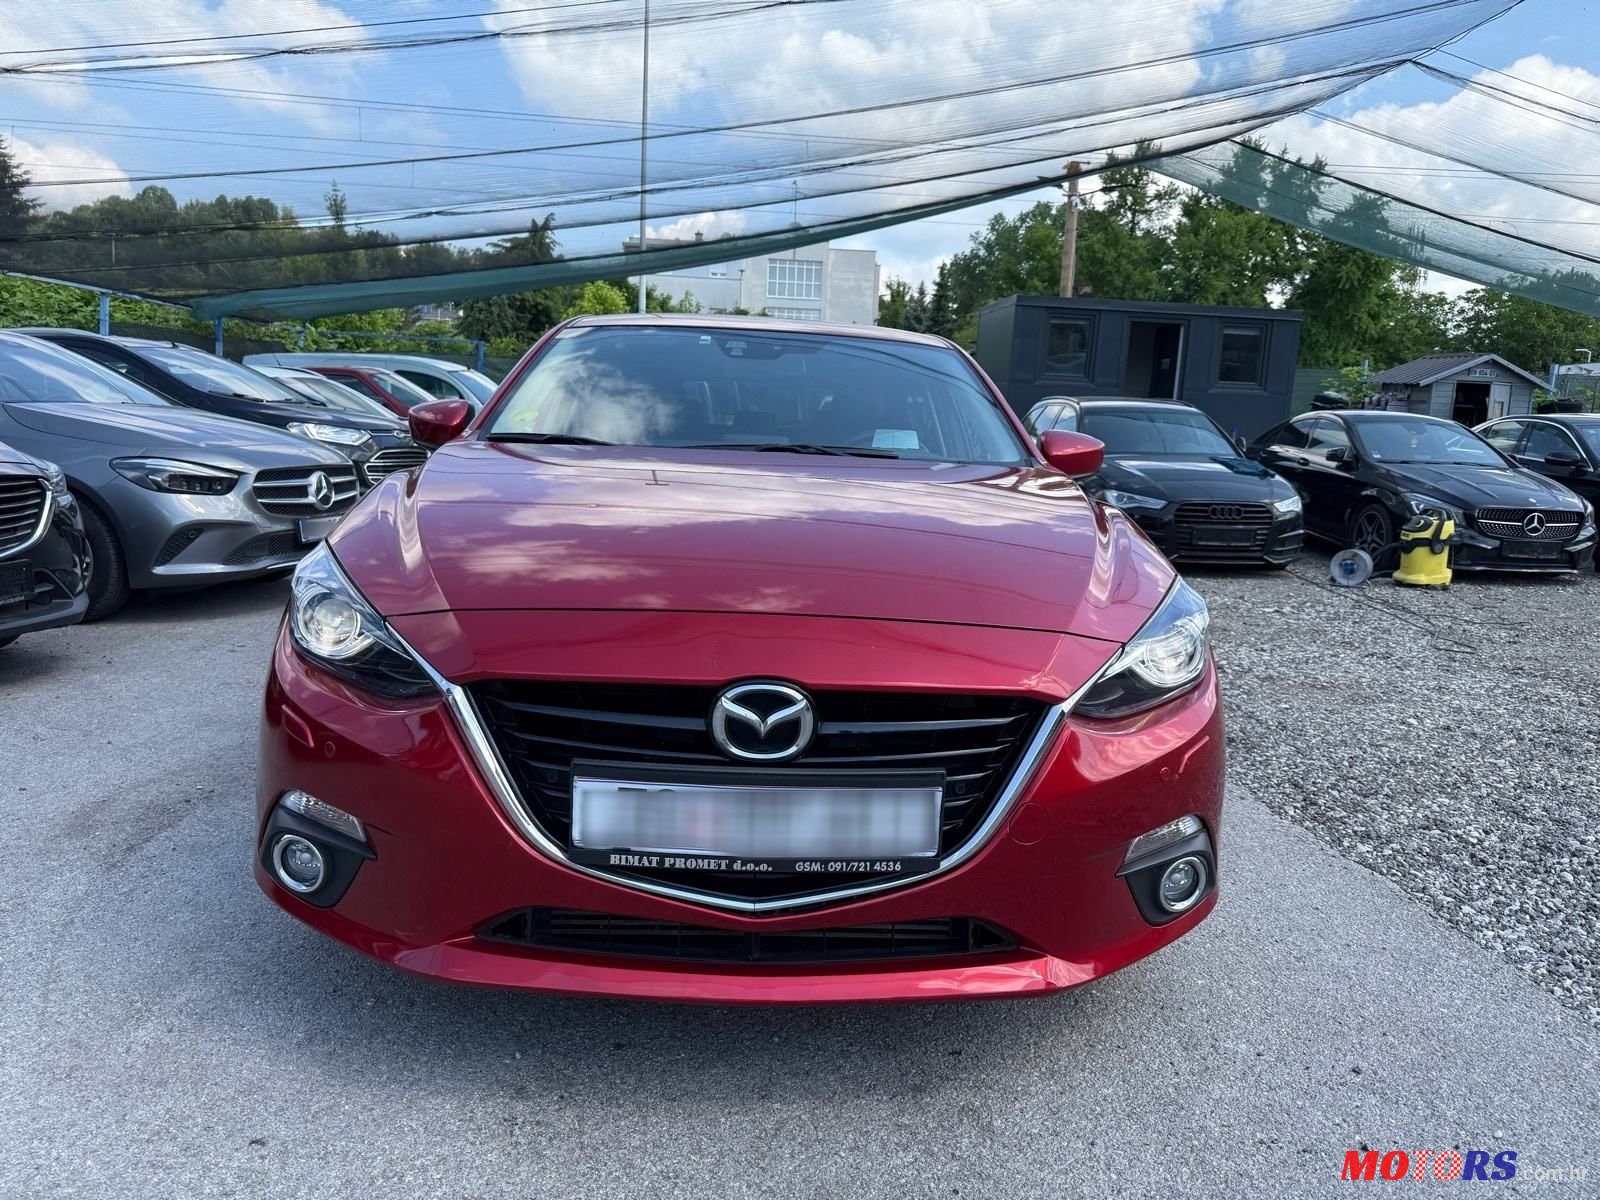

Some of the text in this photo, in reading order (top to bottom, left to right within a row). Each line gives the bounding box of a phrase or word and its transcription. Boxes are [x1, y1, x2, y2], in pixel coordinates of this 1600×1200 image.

[609, 854, 773, 872] BIMAT PROMET d.o.o.
[795, 861, 902, 872] GSM: 091/721 4536
